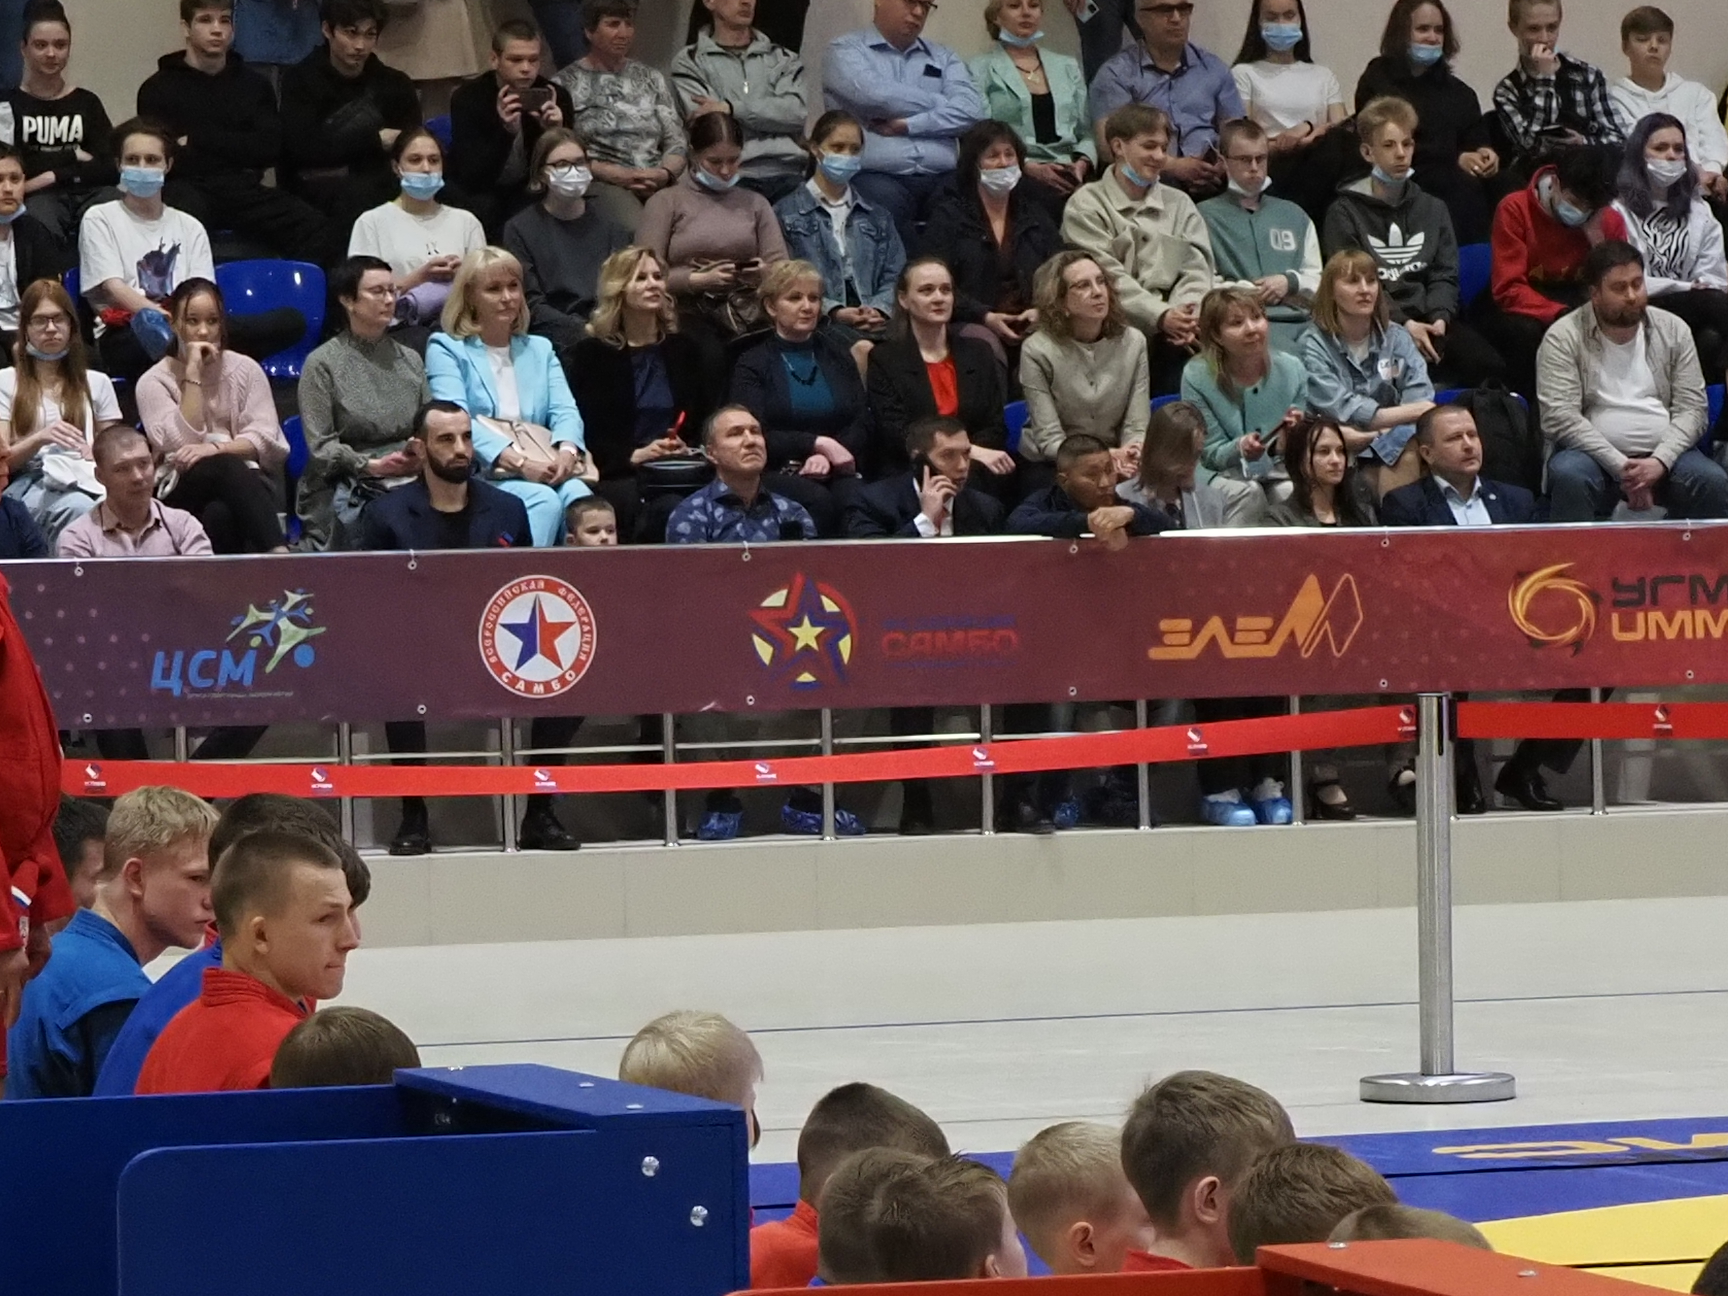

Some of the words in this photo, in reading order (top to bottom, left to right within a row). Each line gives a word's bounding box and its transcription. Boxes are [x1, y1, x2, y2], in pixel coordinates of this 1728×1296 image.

[22, 114, 83, 145] PUMA
[1270, 229, 1296, 250] 09
[150, 649, 257, 697] ЦСМ
[501, 670, 576, 694] САМБО
